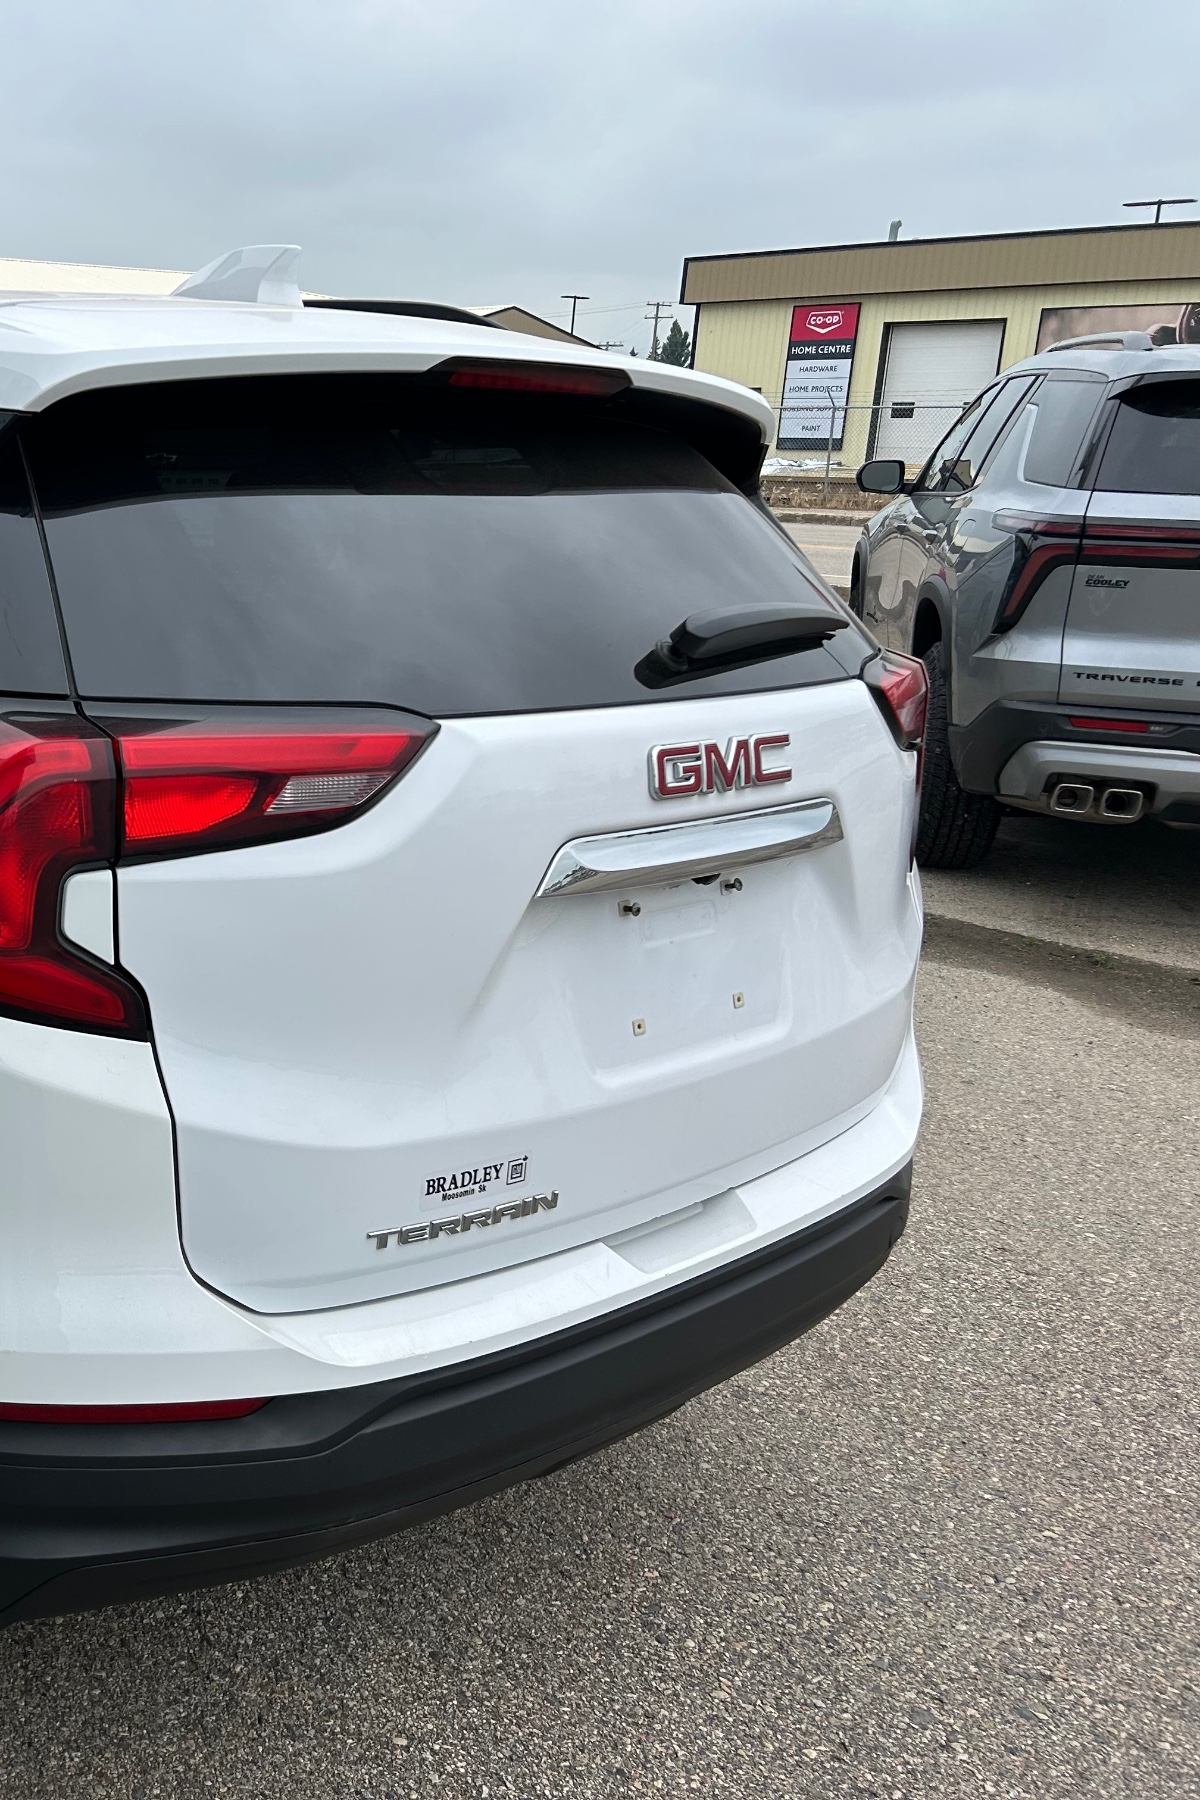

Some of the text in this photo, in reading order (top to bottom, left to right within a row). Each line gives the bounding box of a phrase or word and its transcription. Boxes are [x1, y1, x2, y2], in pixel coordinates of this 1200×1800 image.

[810, 315, 839, 325] CO-OP
[791, 344, 852, 355] HOME CENTRE
[799, 365, 838, 373] HARDWARE
[789, 385, 843, 393] HOME PROJECTS
[1085, 579, 1130, 587] COOLEY
[1073, 672, 1184, 687] TRAVERSE
[647, 730, 793, 801] GMC
[424, 1162, 504, 1196] BRADLEY
[441, 1184, 487, 1202] Moosomin Sk
[366, 1190, 559, 1250] TERRAIN
